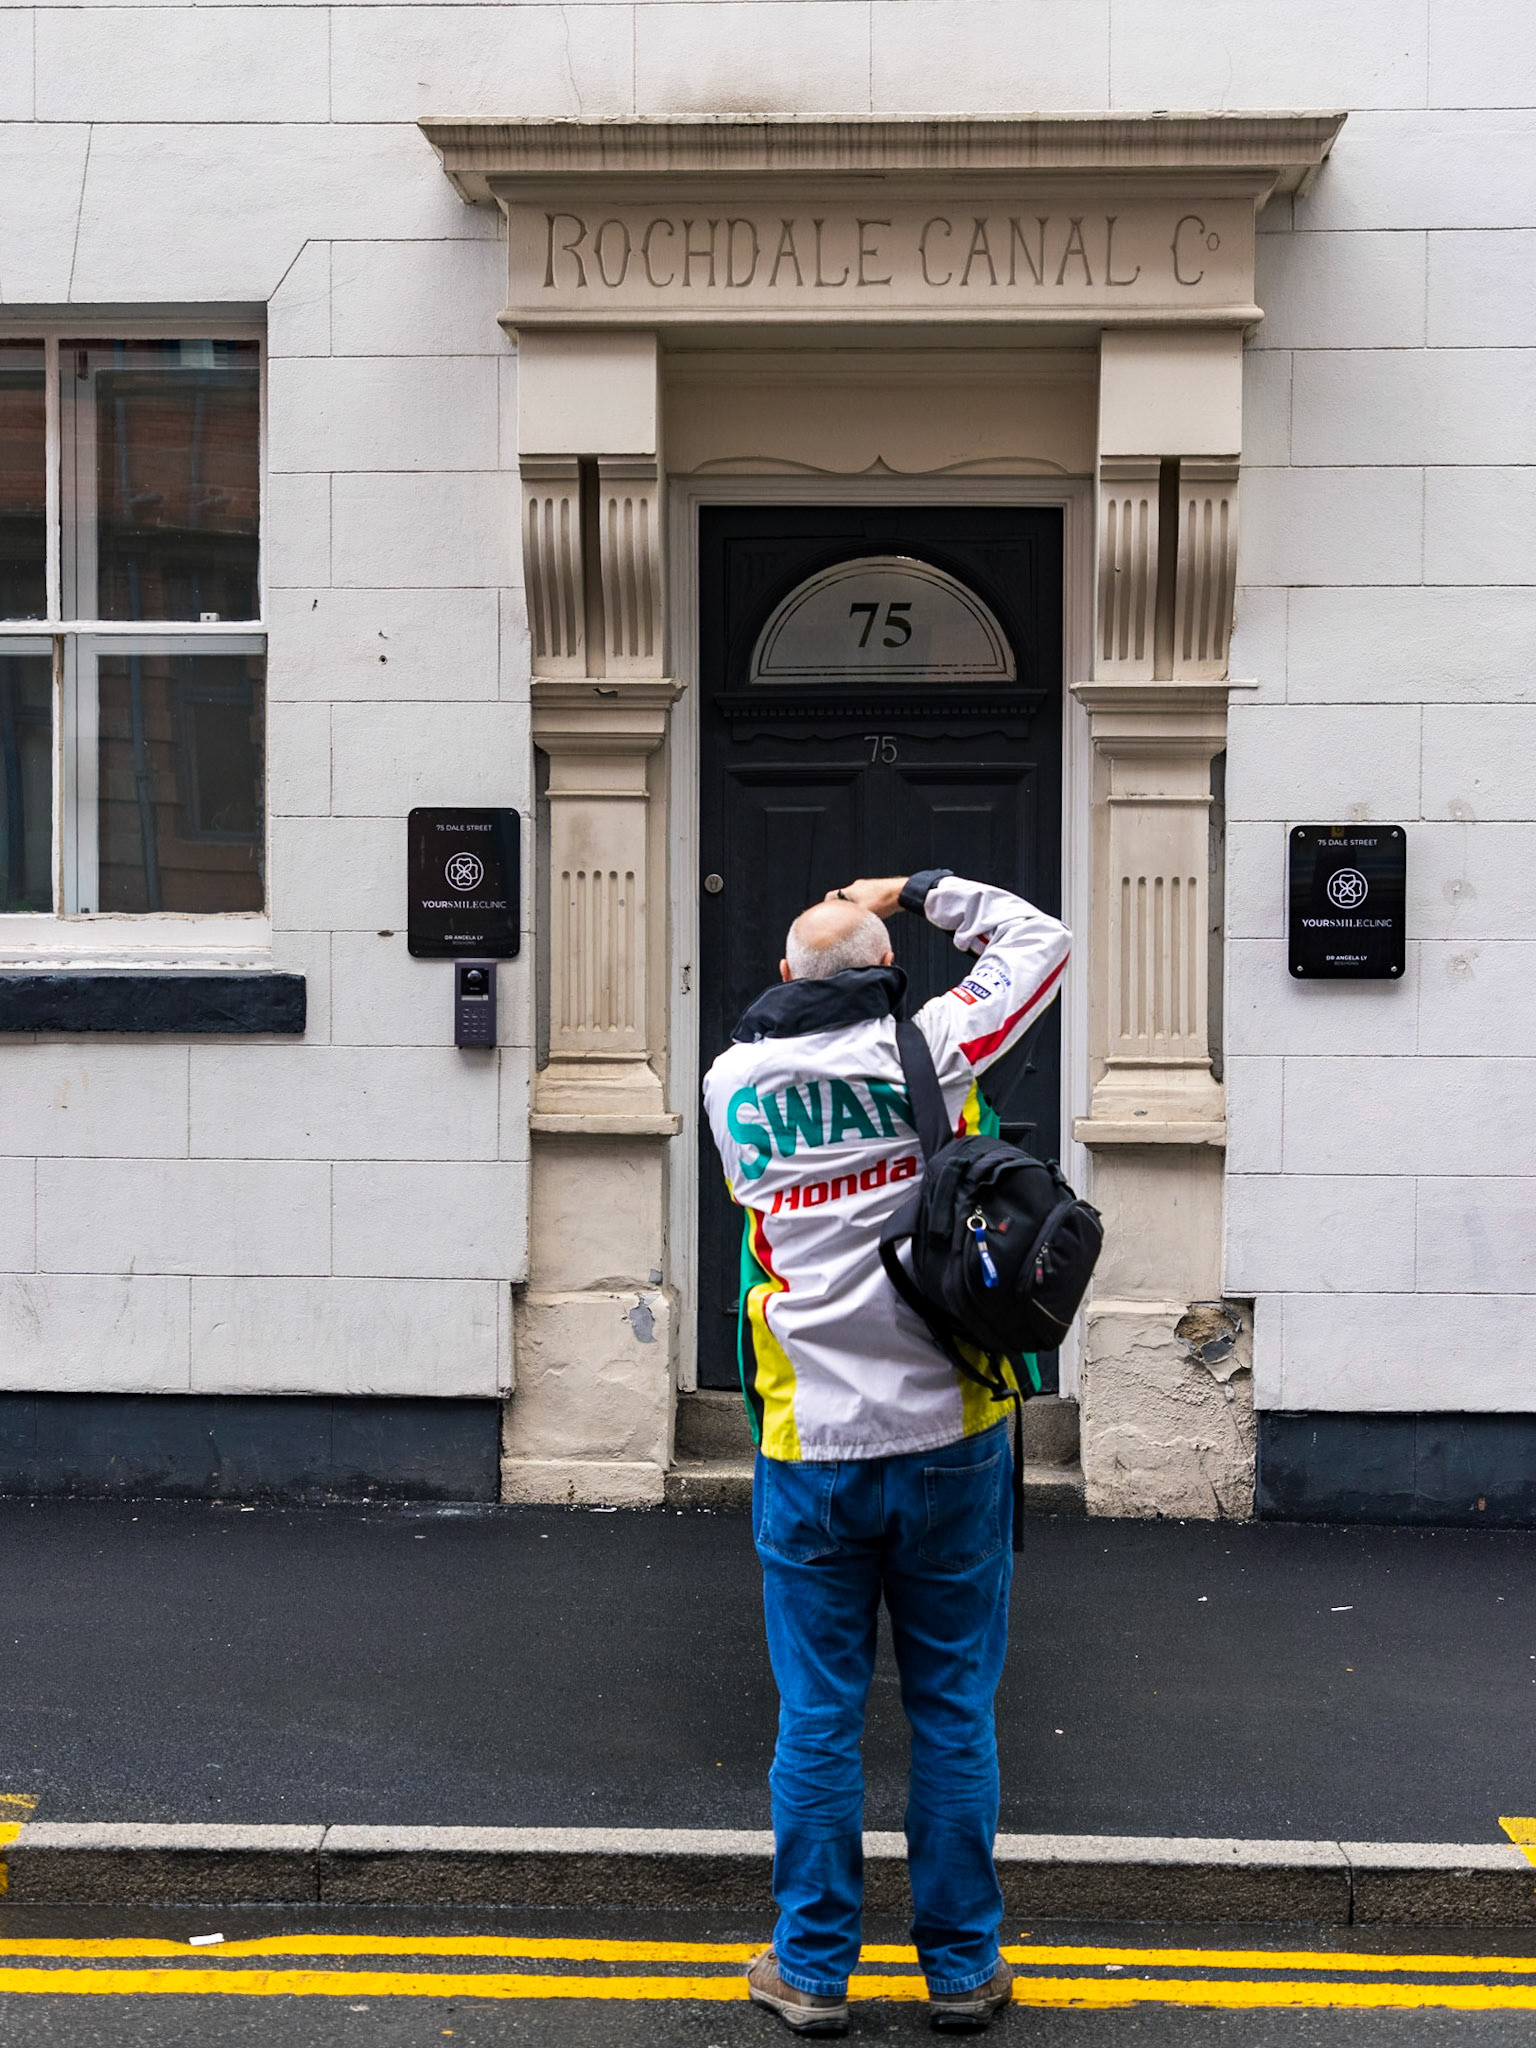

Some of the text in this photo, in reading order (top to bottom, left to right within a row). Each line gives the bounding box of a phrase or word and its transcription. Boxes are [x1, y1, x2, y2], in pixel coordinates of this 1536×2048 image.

[543, 213, 893, 288] ROCHDALE
[918, 216, 1141, 287] CANAL
[850, 603, 912, 648] 75
[864, 735, 898, 764] 75
[727, 1077, 918, 1180] SWAN
[771, 1155, 917, 1215] Honda
